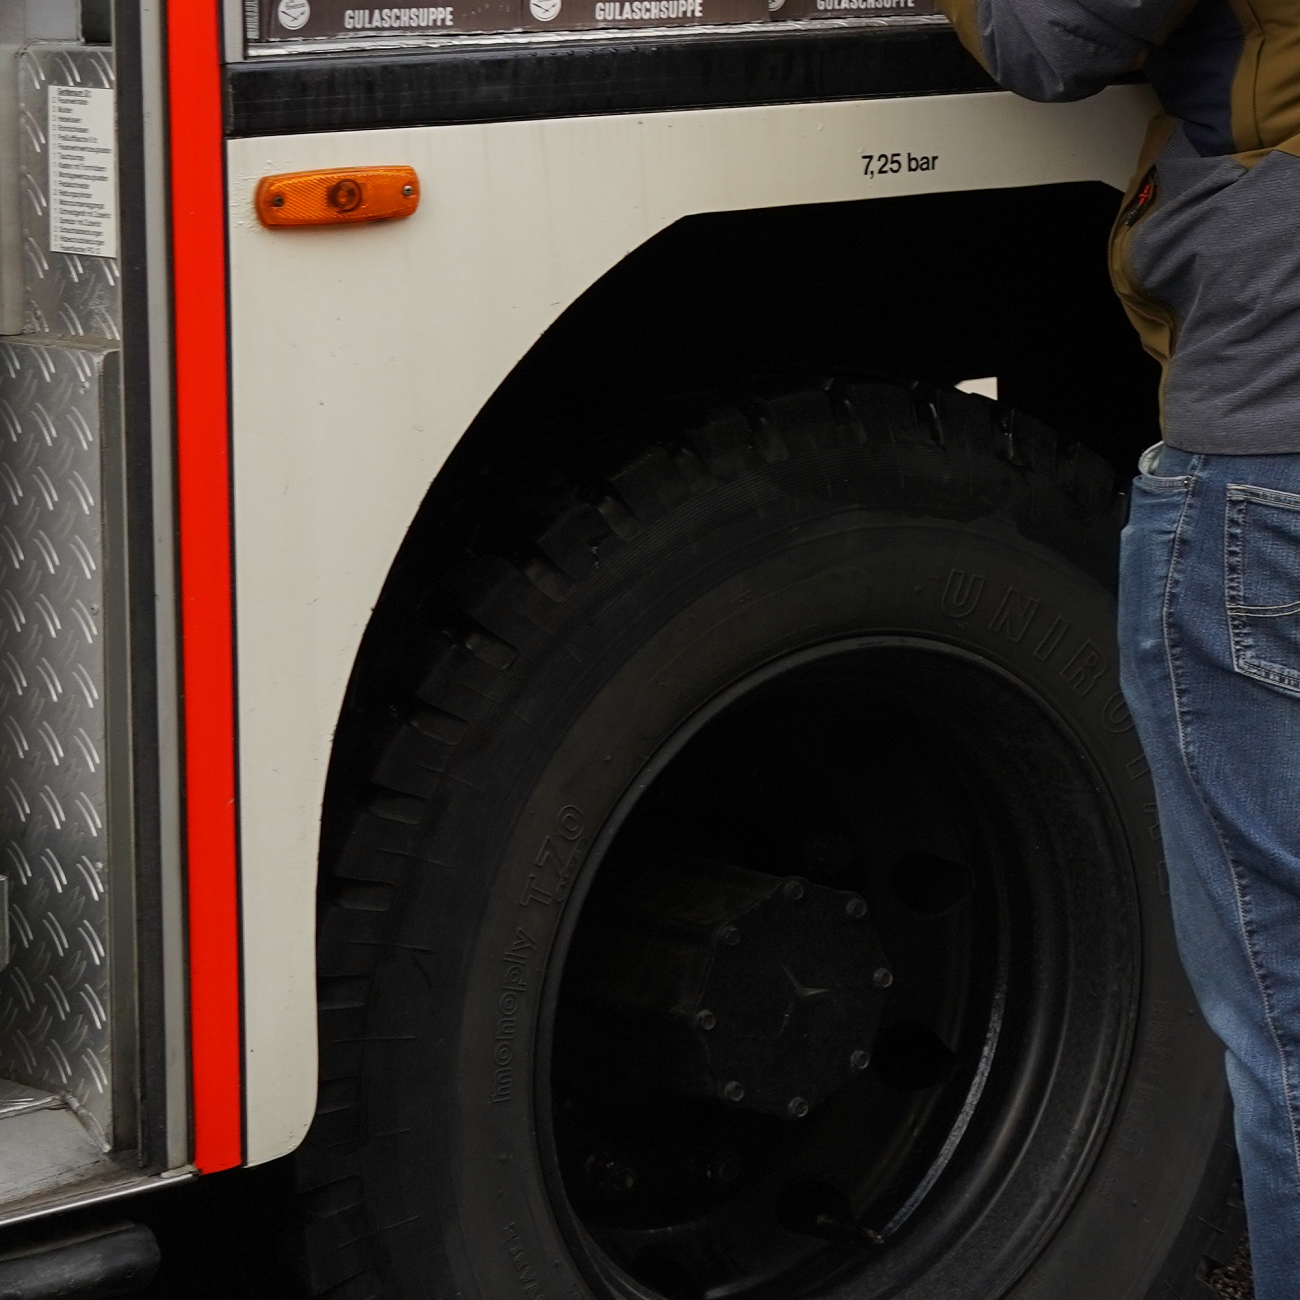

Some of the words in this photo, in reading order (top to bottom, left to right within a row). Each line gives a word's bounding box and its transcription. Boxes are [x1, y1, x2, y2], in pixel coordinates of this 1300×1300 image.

[344, 6, 454, 29] GULASCHSUPPE
[861, 153, 902, 179] 7,25
[907, 152, 939, 172] bar
